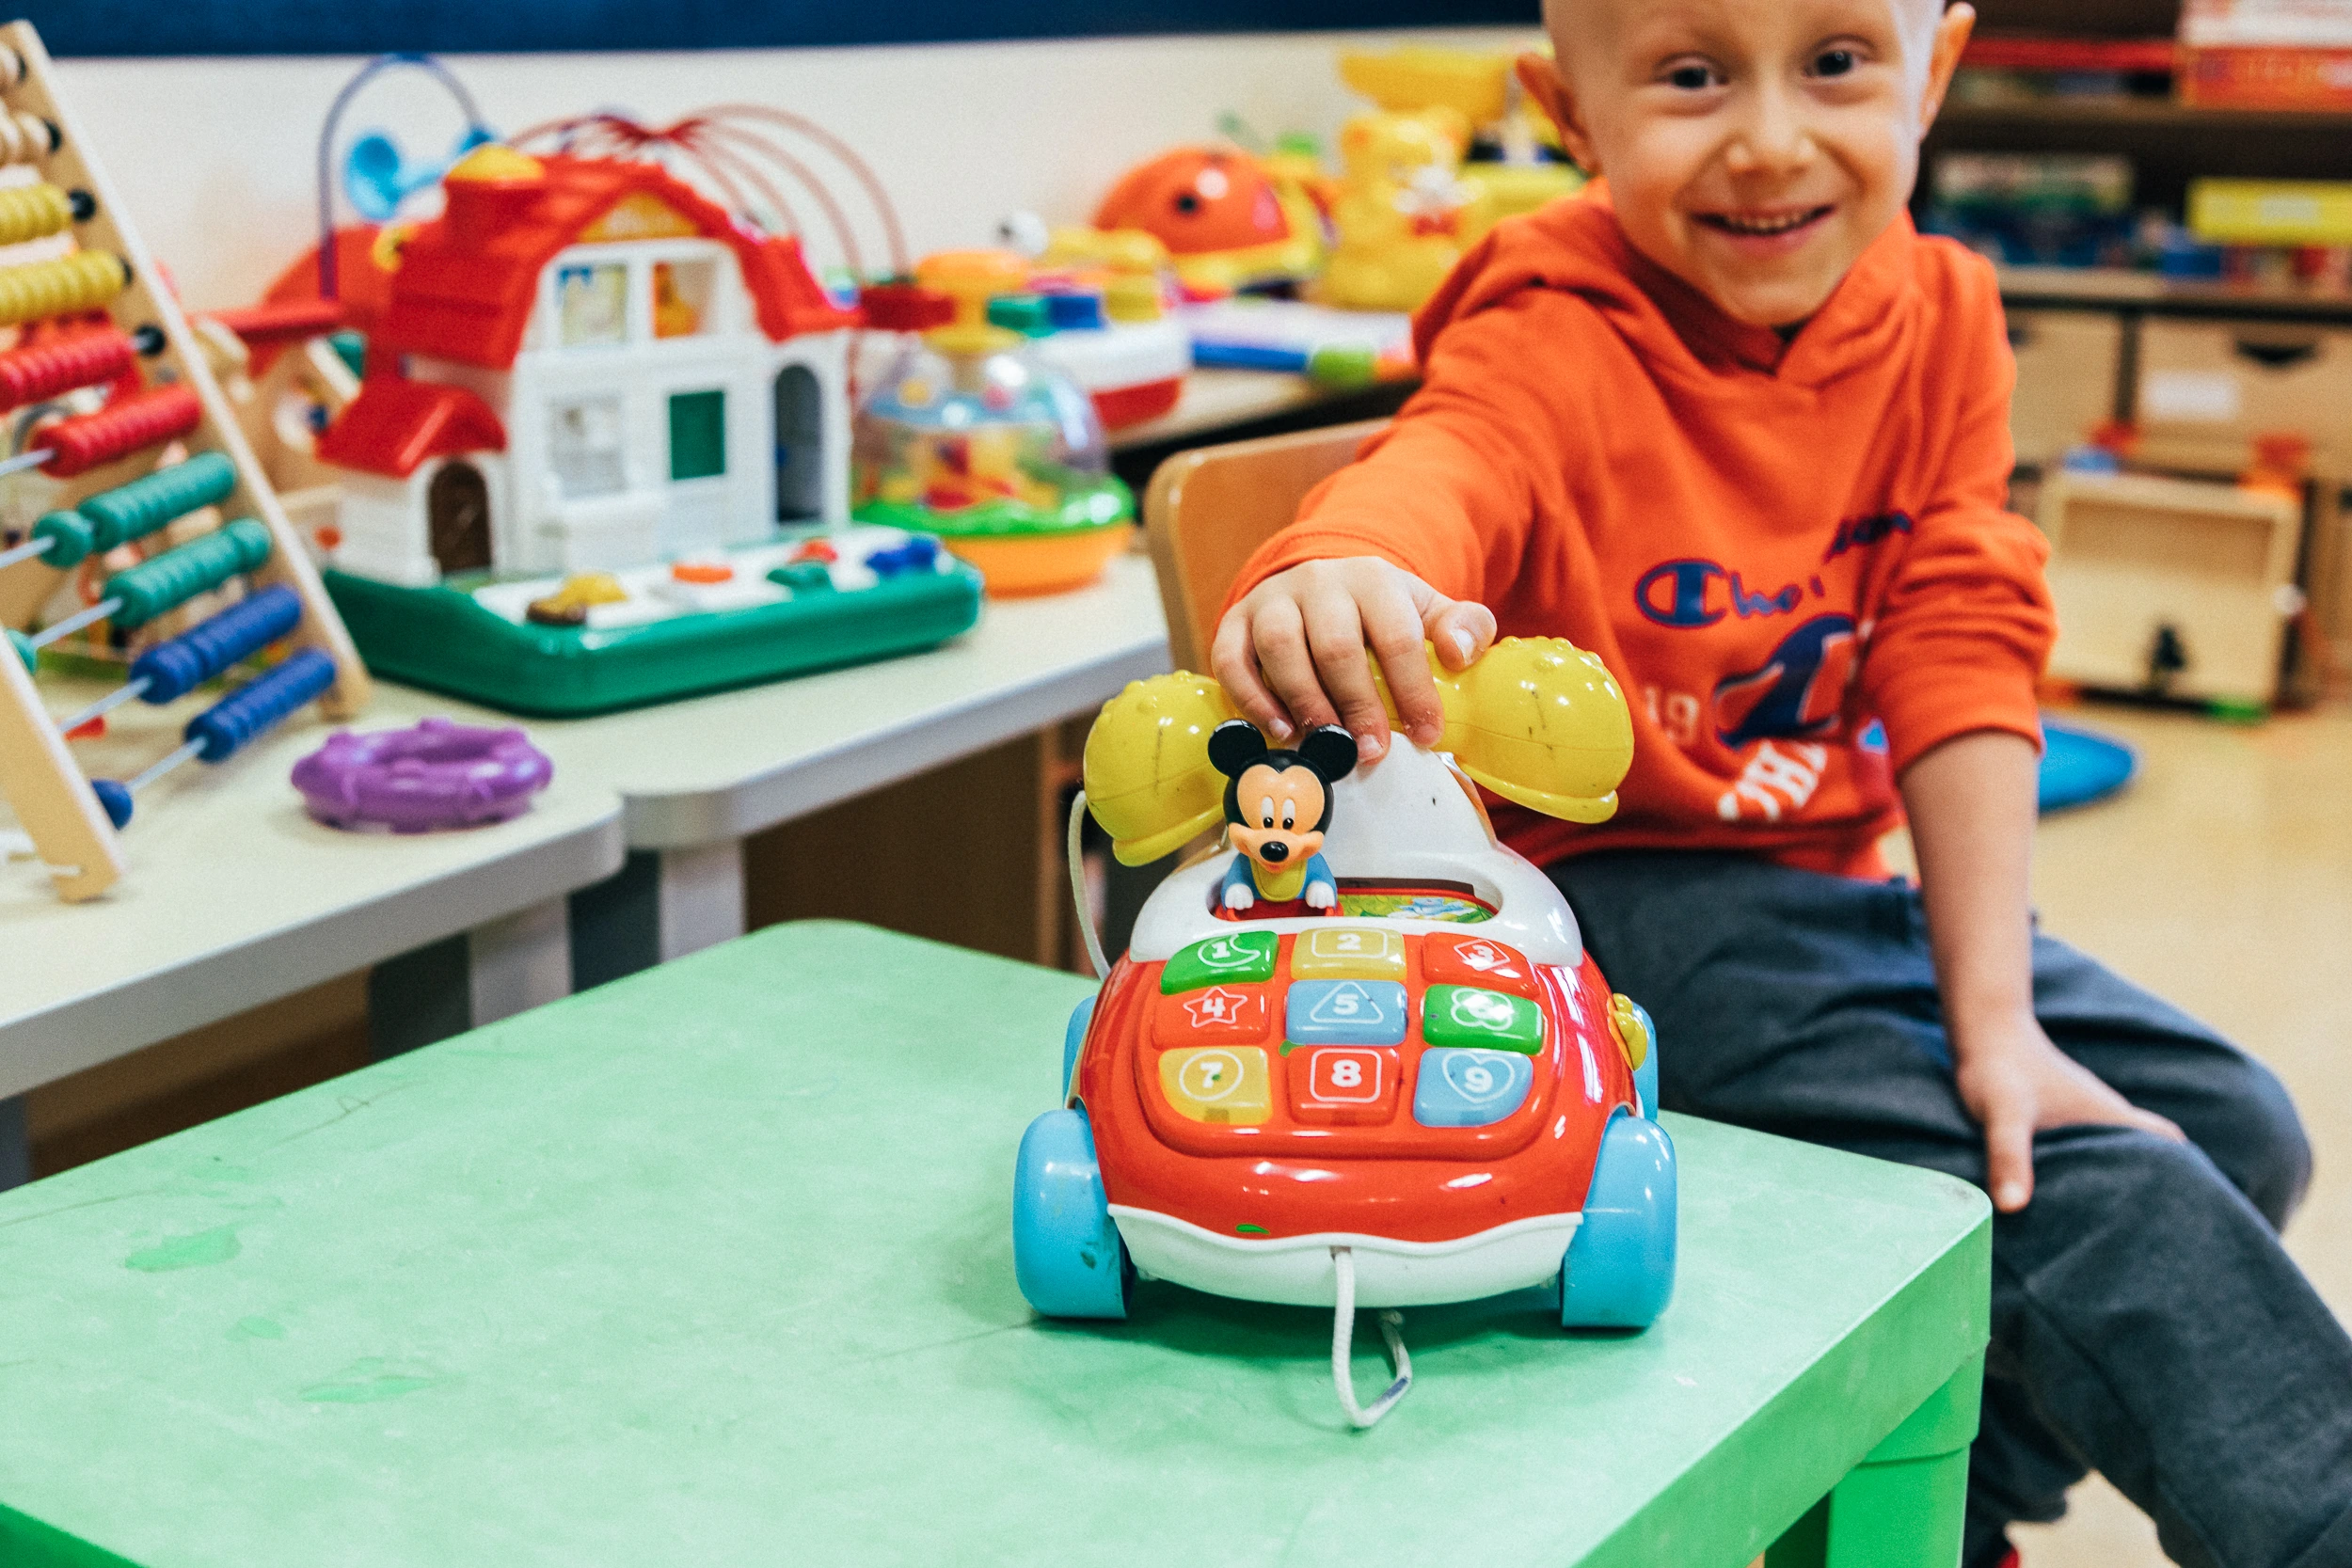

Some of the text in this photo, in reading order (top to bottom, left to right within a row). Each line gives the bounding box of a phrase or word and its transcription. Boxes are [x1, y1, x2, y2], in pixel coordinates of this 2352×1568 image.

[1211, 941, 1232, 959] 1
[1337, 932, 1362, 951] 2
[1468, 944, 1495, 968] 3
[1201, 997, 1226, 1018] 4
[1333, 993, 1359, 1016] 5
[1200, 1062, 1223, 1088] 7
[1331, 1059, 1362, 1087] 8
[1464, 1067, 1494, 1093] 9
